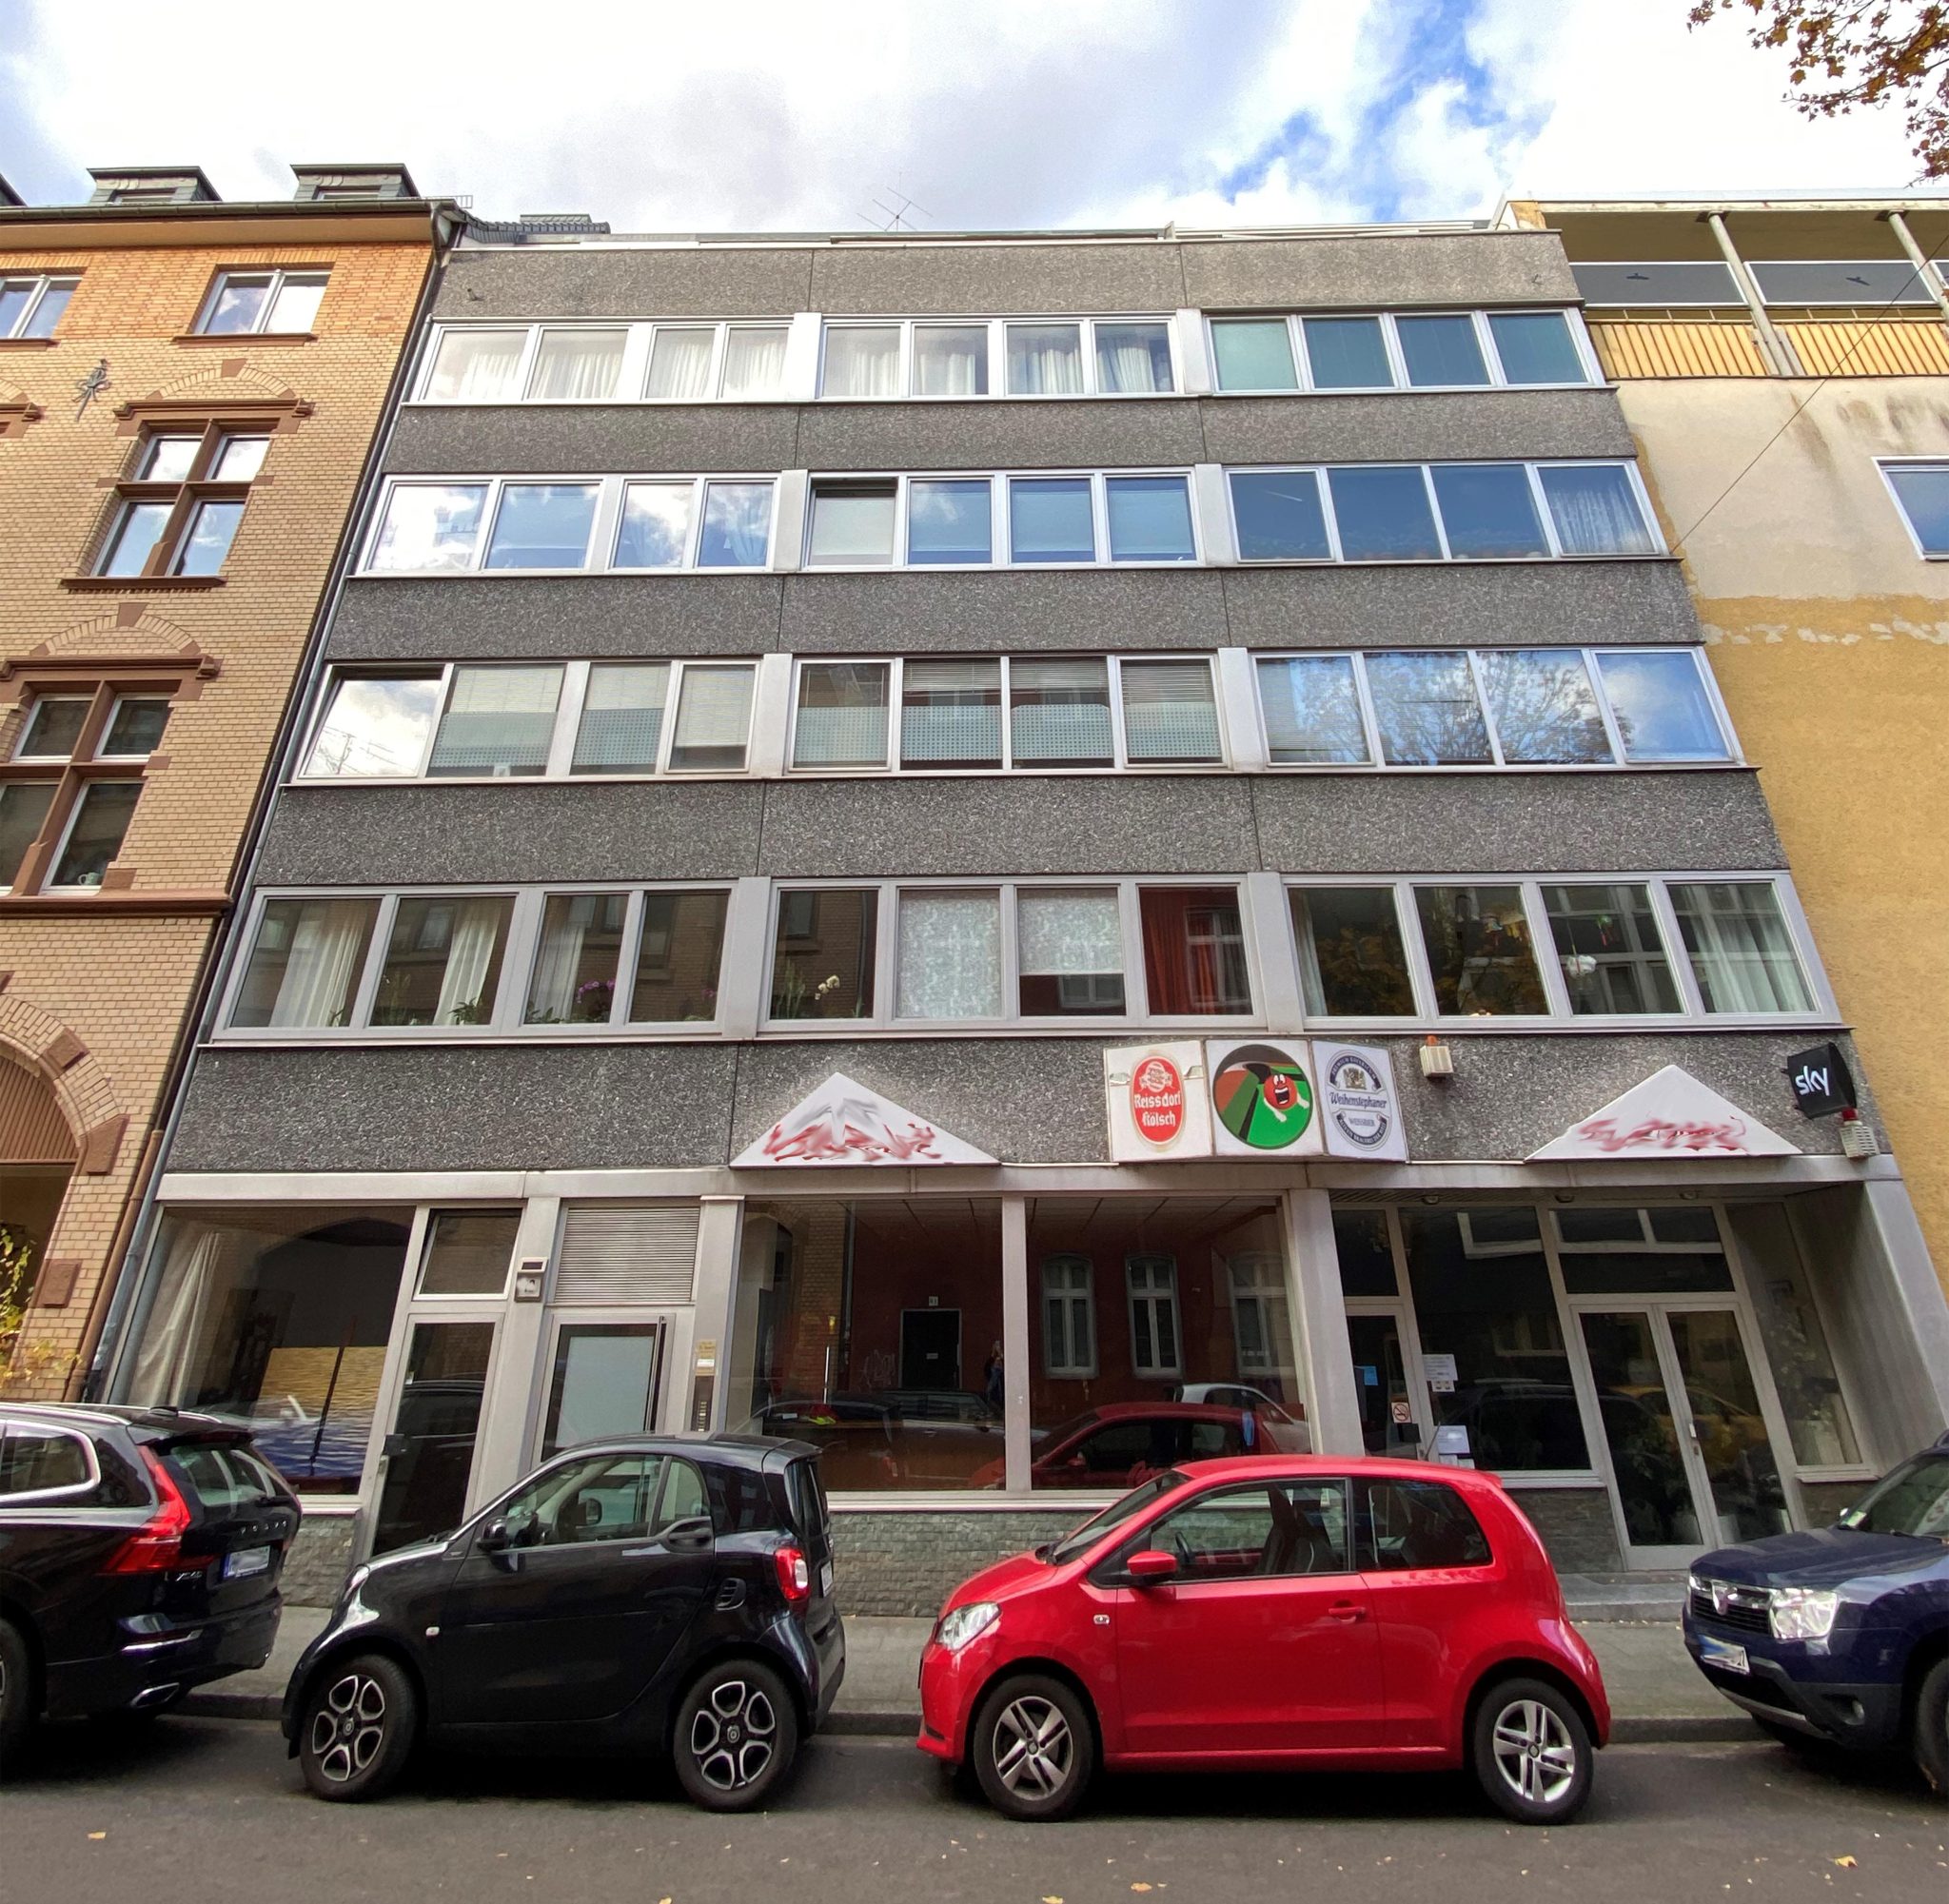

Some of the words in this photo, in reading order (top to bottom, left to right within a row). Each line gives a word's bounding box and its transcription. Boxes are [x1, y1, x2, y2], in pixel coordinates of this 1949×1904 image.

[1795, 1065, 1830, 1096] sky
[1133, 1090, 1181, 1109] Reissdorf
[1329, 1091, 1388, 1109] Weihenstephaner
[1142, 1110, 1176, 1127] Kölsch
